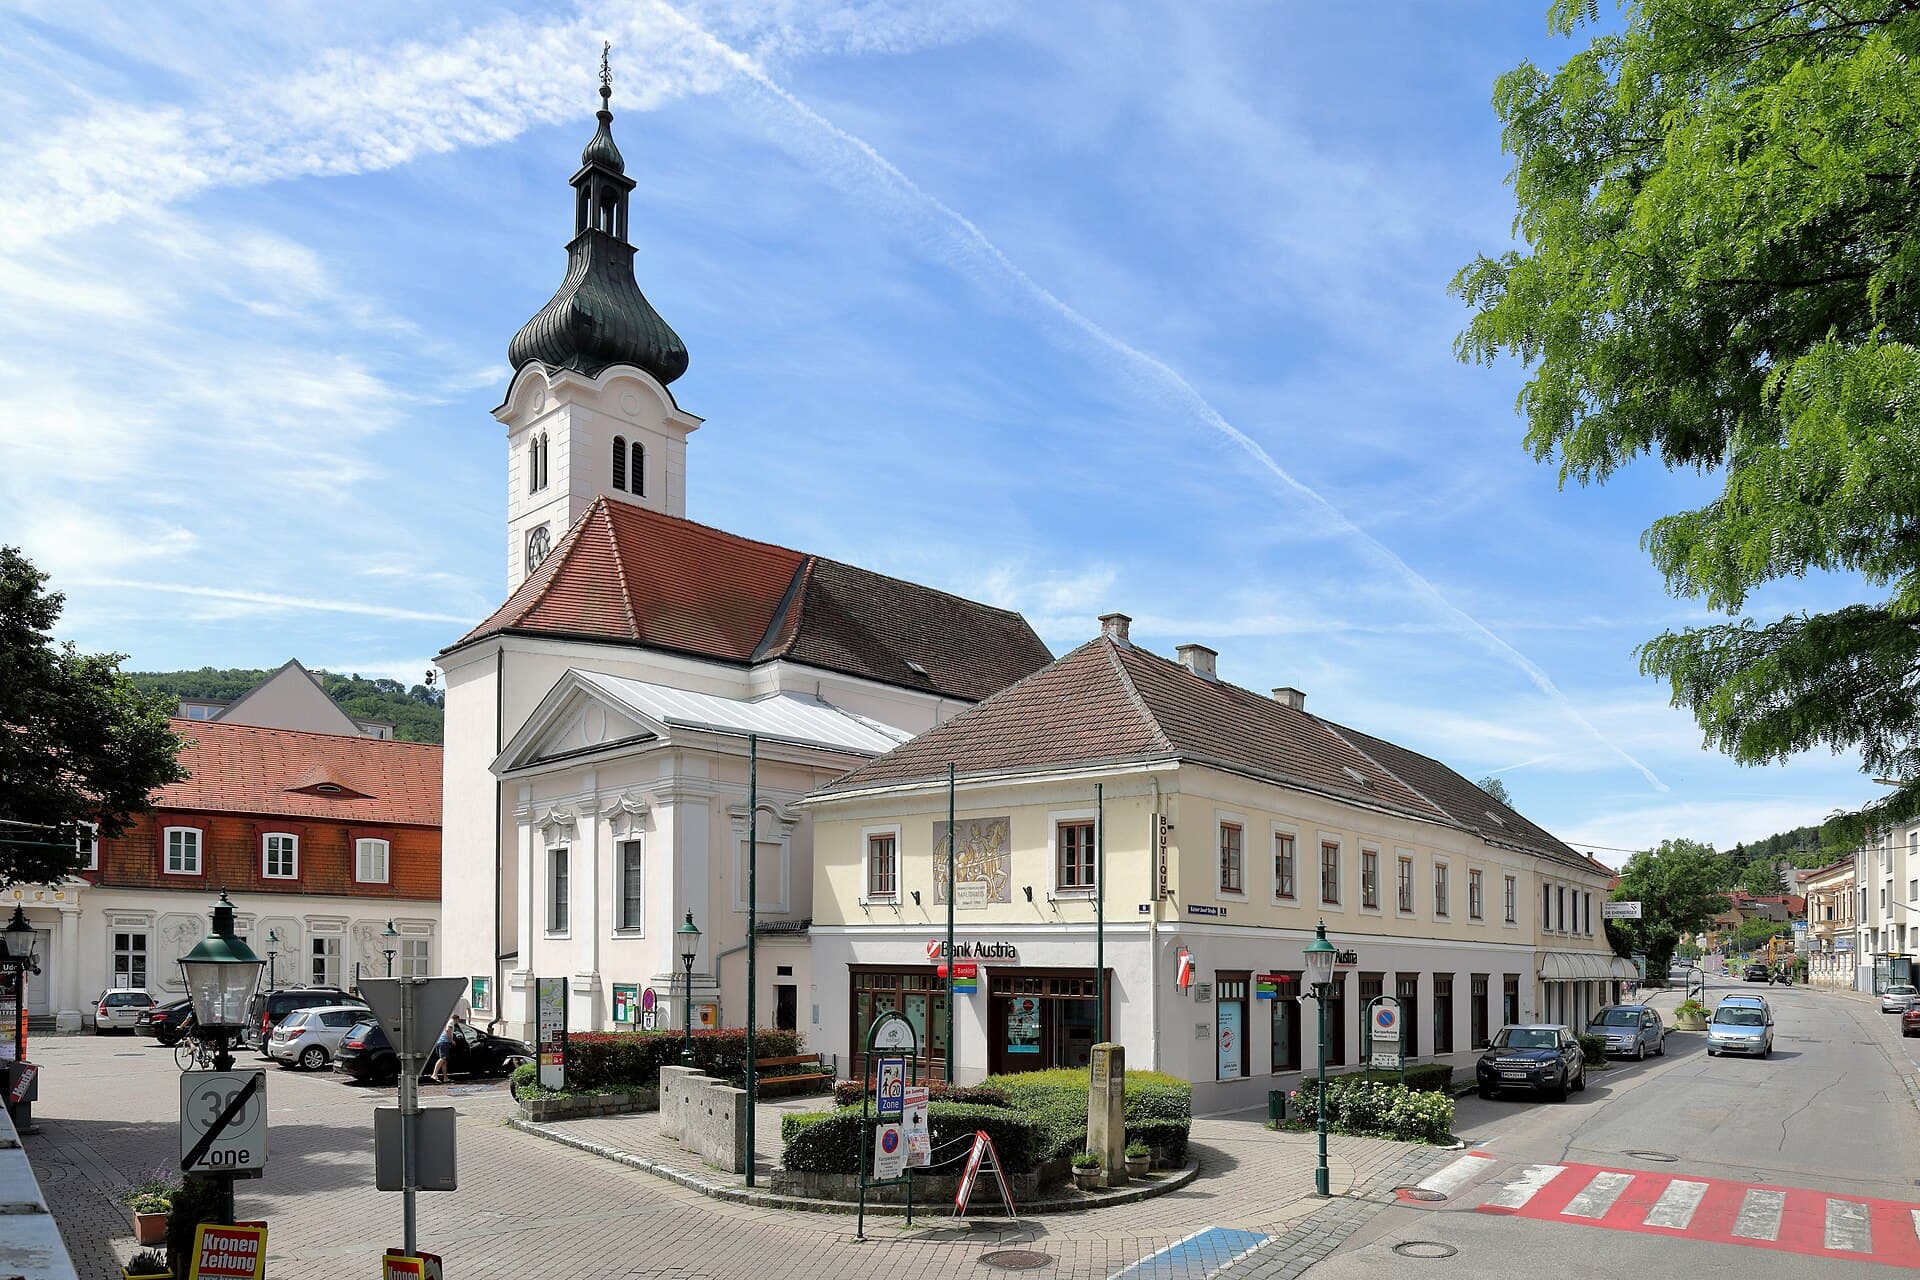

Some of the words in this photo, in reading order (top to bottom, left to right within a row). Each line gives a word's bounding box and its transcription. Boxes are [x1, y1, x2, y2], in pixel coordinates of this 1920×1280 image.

[942, 941, 971, 958] Bank
[974, 941, 1016, 958] Austria
[1335, 949, 1358, 965] Austria
[12, 1067, 34, 1100] Heute
[892, 1084, 901, 1096] 20
[200, 1090, 246, 1128] 30
[882, 1099, 900, 1109] Zone
[197, 1146, 250, 1166] Zone
[203, 1233, 258, 1253] Kronen
[201, 1251, 256, 1272] Zeitung
